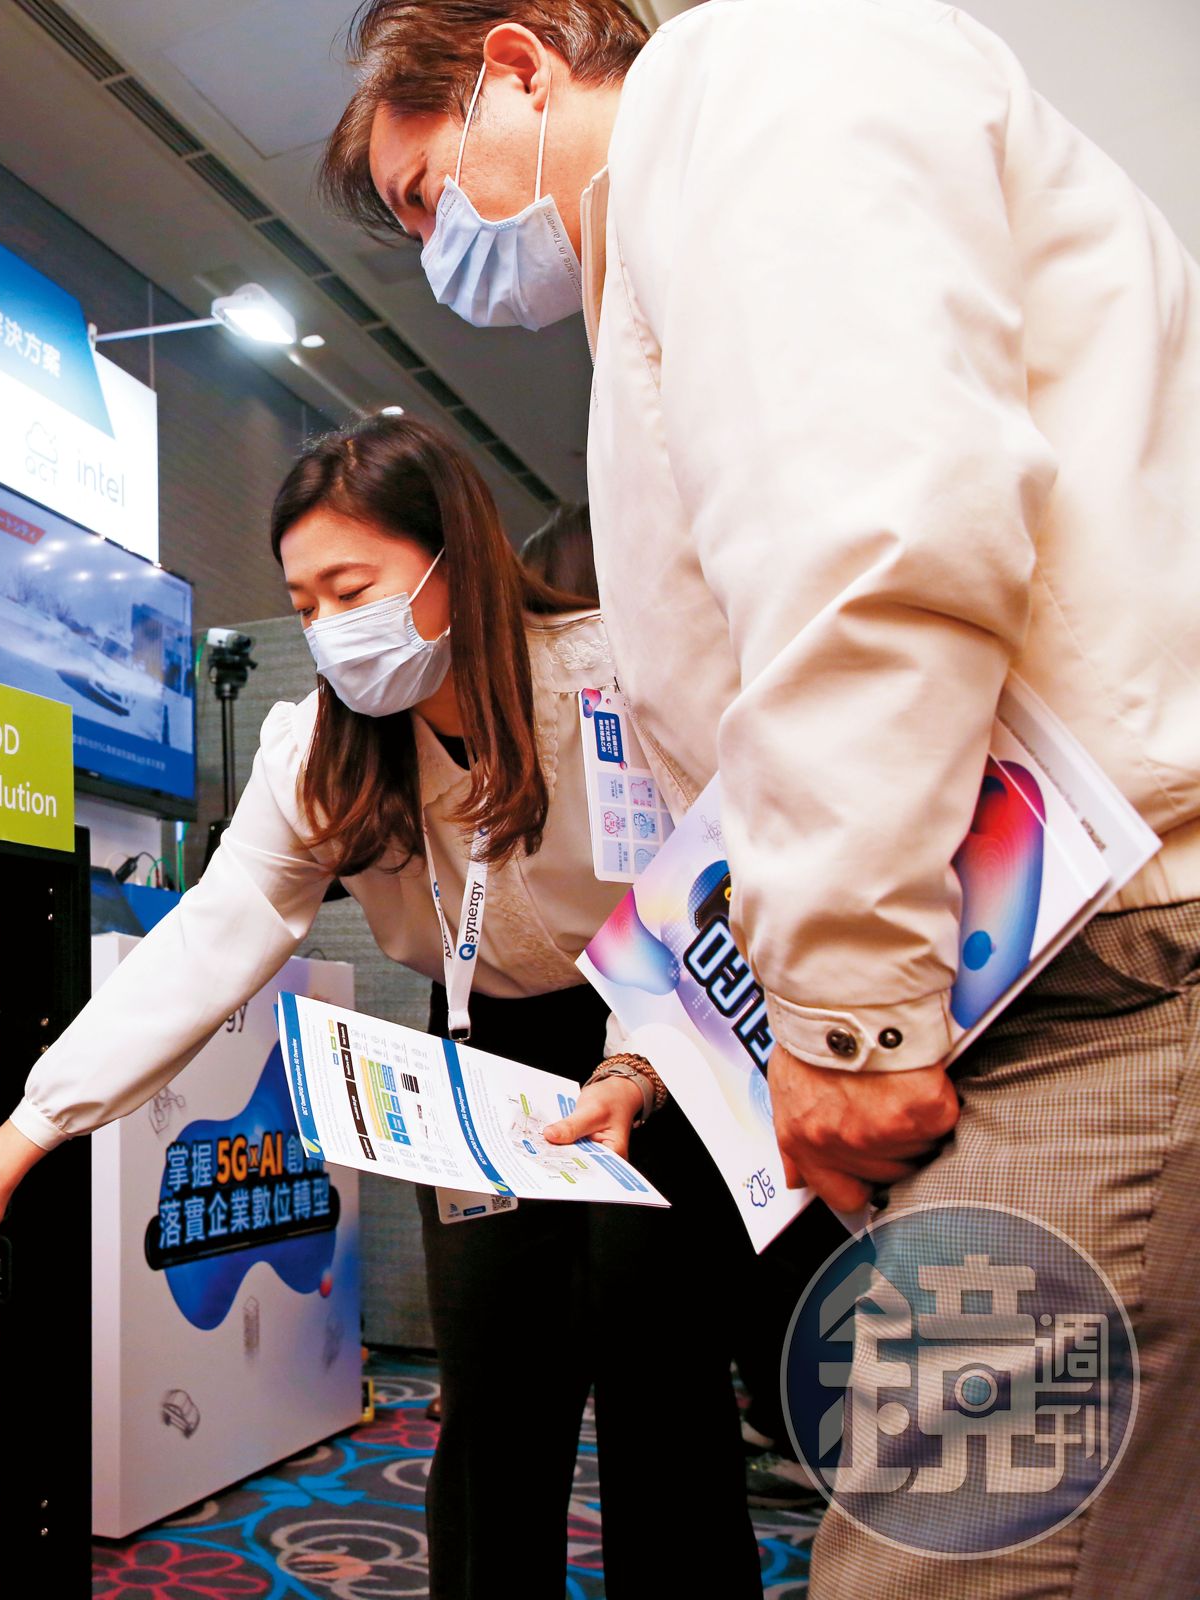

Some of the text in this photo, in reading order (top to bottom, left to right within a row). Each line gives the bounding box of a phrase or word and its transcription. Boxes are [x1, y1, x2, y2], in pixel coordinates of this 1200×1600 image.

[76, 448, 126, 508] intel
[459, 881, 485, 961] Q.synergy
[158, 1178, 331, 1249] 落實企業數位轉型
[757, 1168, 776, 1199] QCT
